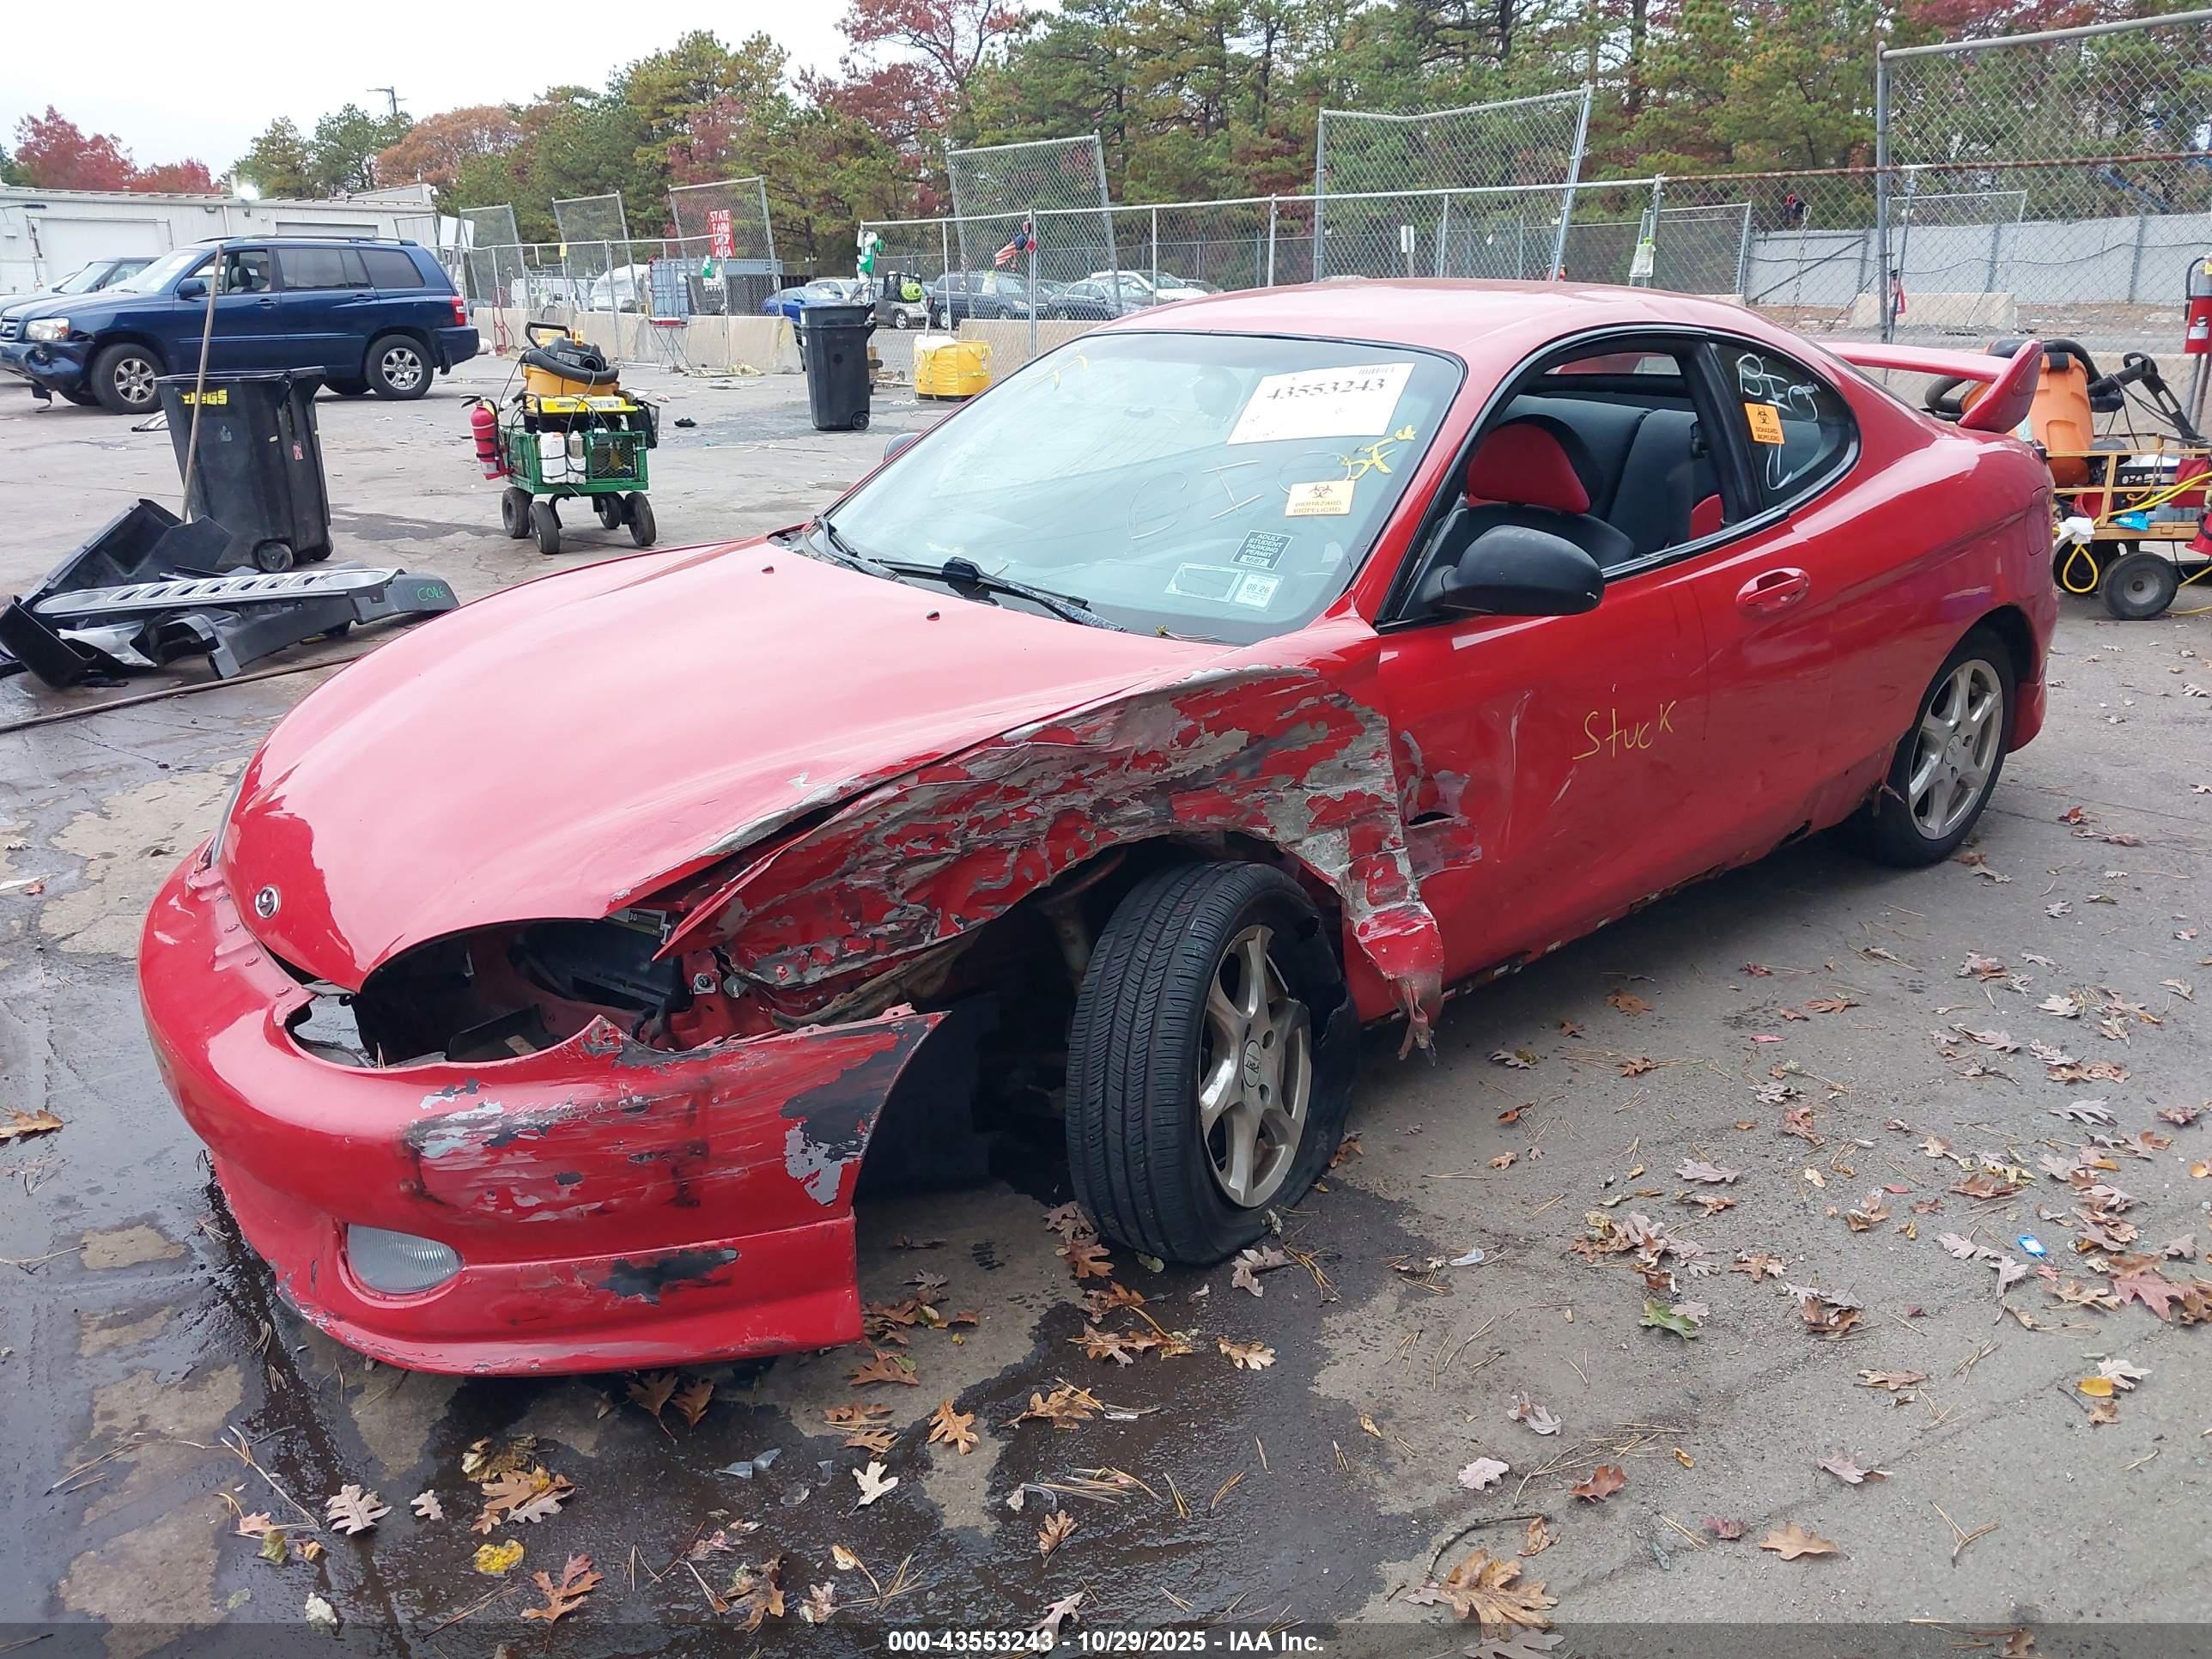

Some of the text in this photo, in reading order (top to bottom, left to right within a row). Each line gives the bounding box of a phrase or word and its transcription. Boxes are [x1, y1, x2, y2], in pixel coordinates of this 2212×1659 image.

[709, 210, 730, 222] STATE
[713, 222, 730, 234] FARM
[1267, 378, 1386, 400] 43553243
[1256, 533, 1282, 542] ADULT
[1249, 538, 1284, 548] STUDENT
[1244, 549, 1273, 558] PERMIT
[1246, 543, 1279, 554] PARKING
[1259, 585, 1271, 593] 26
